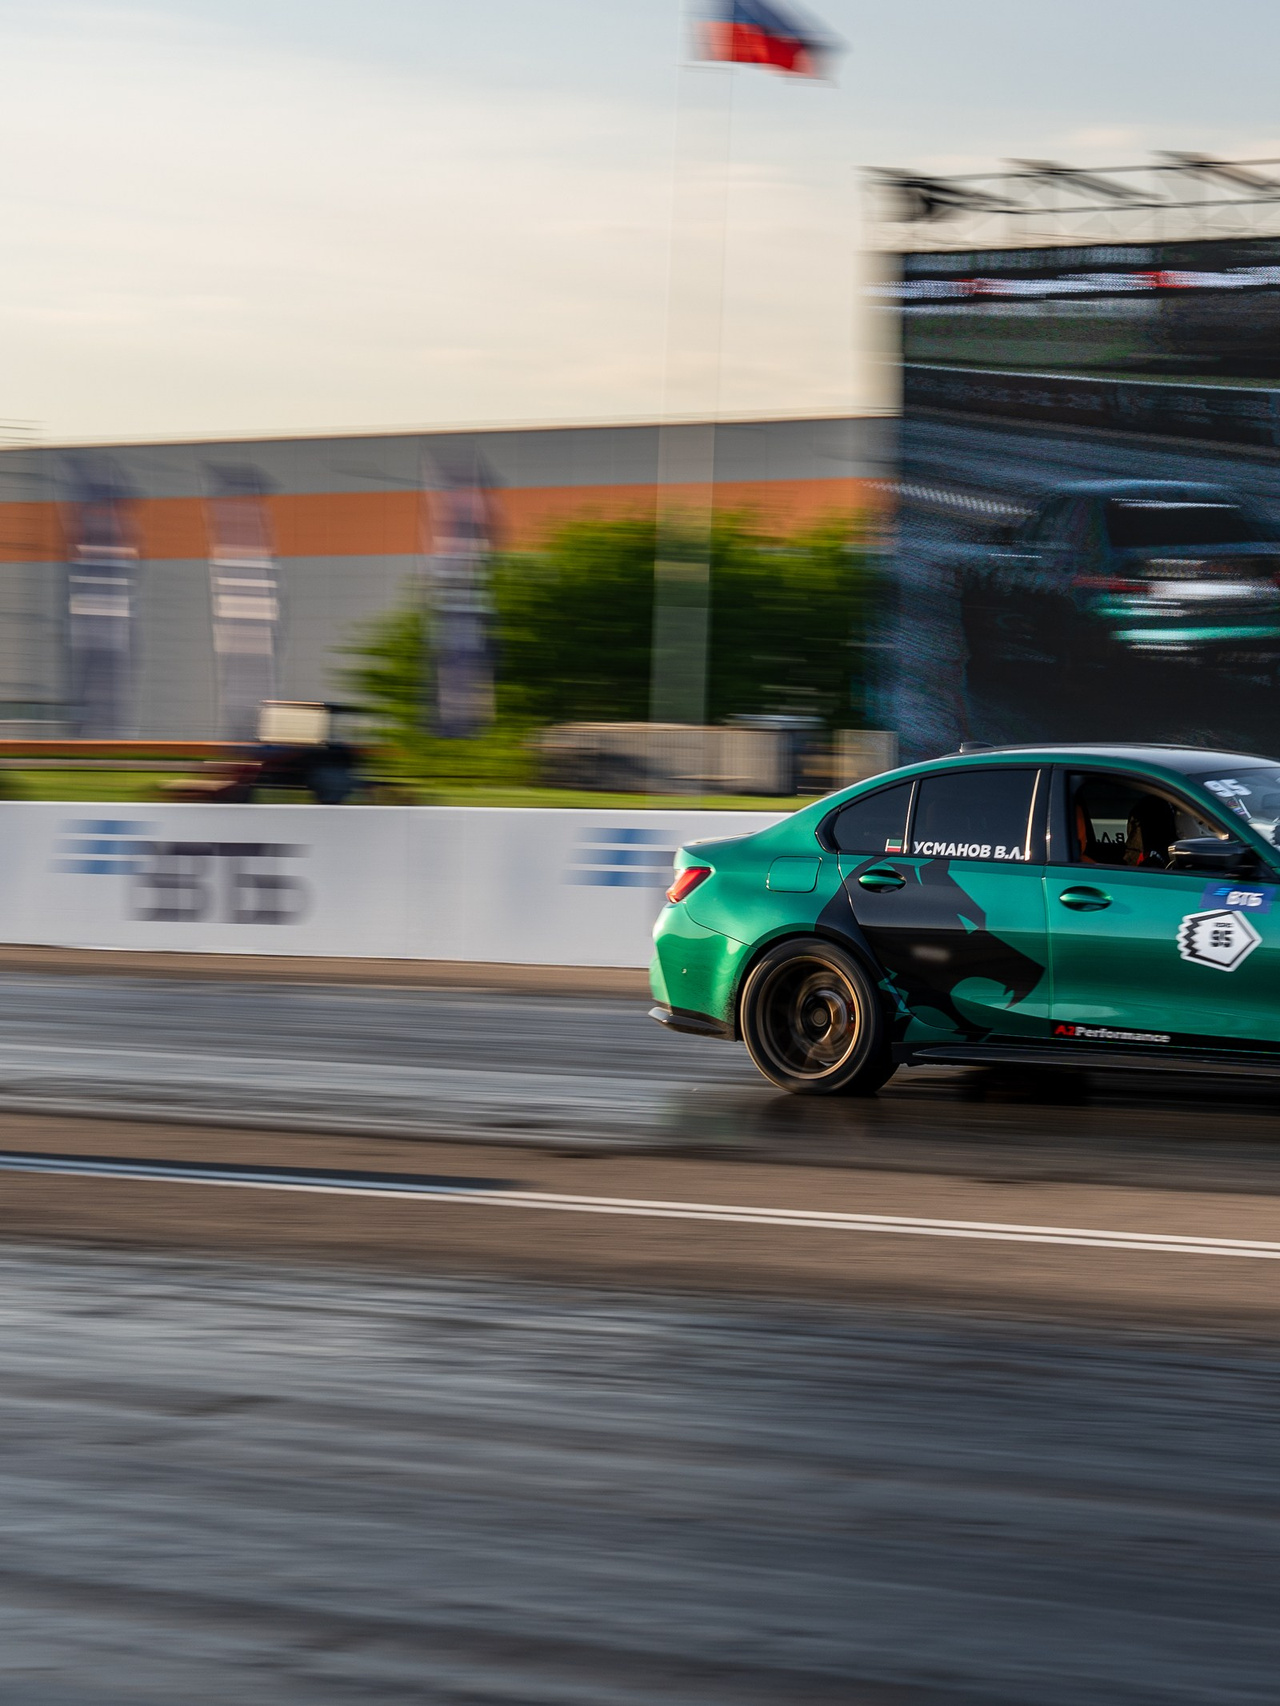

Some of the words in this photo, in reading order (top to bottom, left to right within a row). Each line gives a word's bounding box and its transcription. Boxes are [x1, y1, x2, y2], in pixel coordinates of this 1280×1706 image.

[1203, 779, 1252, 797] 95
[913, 841, 991, 858] УСМАНОВ
[1211, 930, 1233, 948] 95
